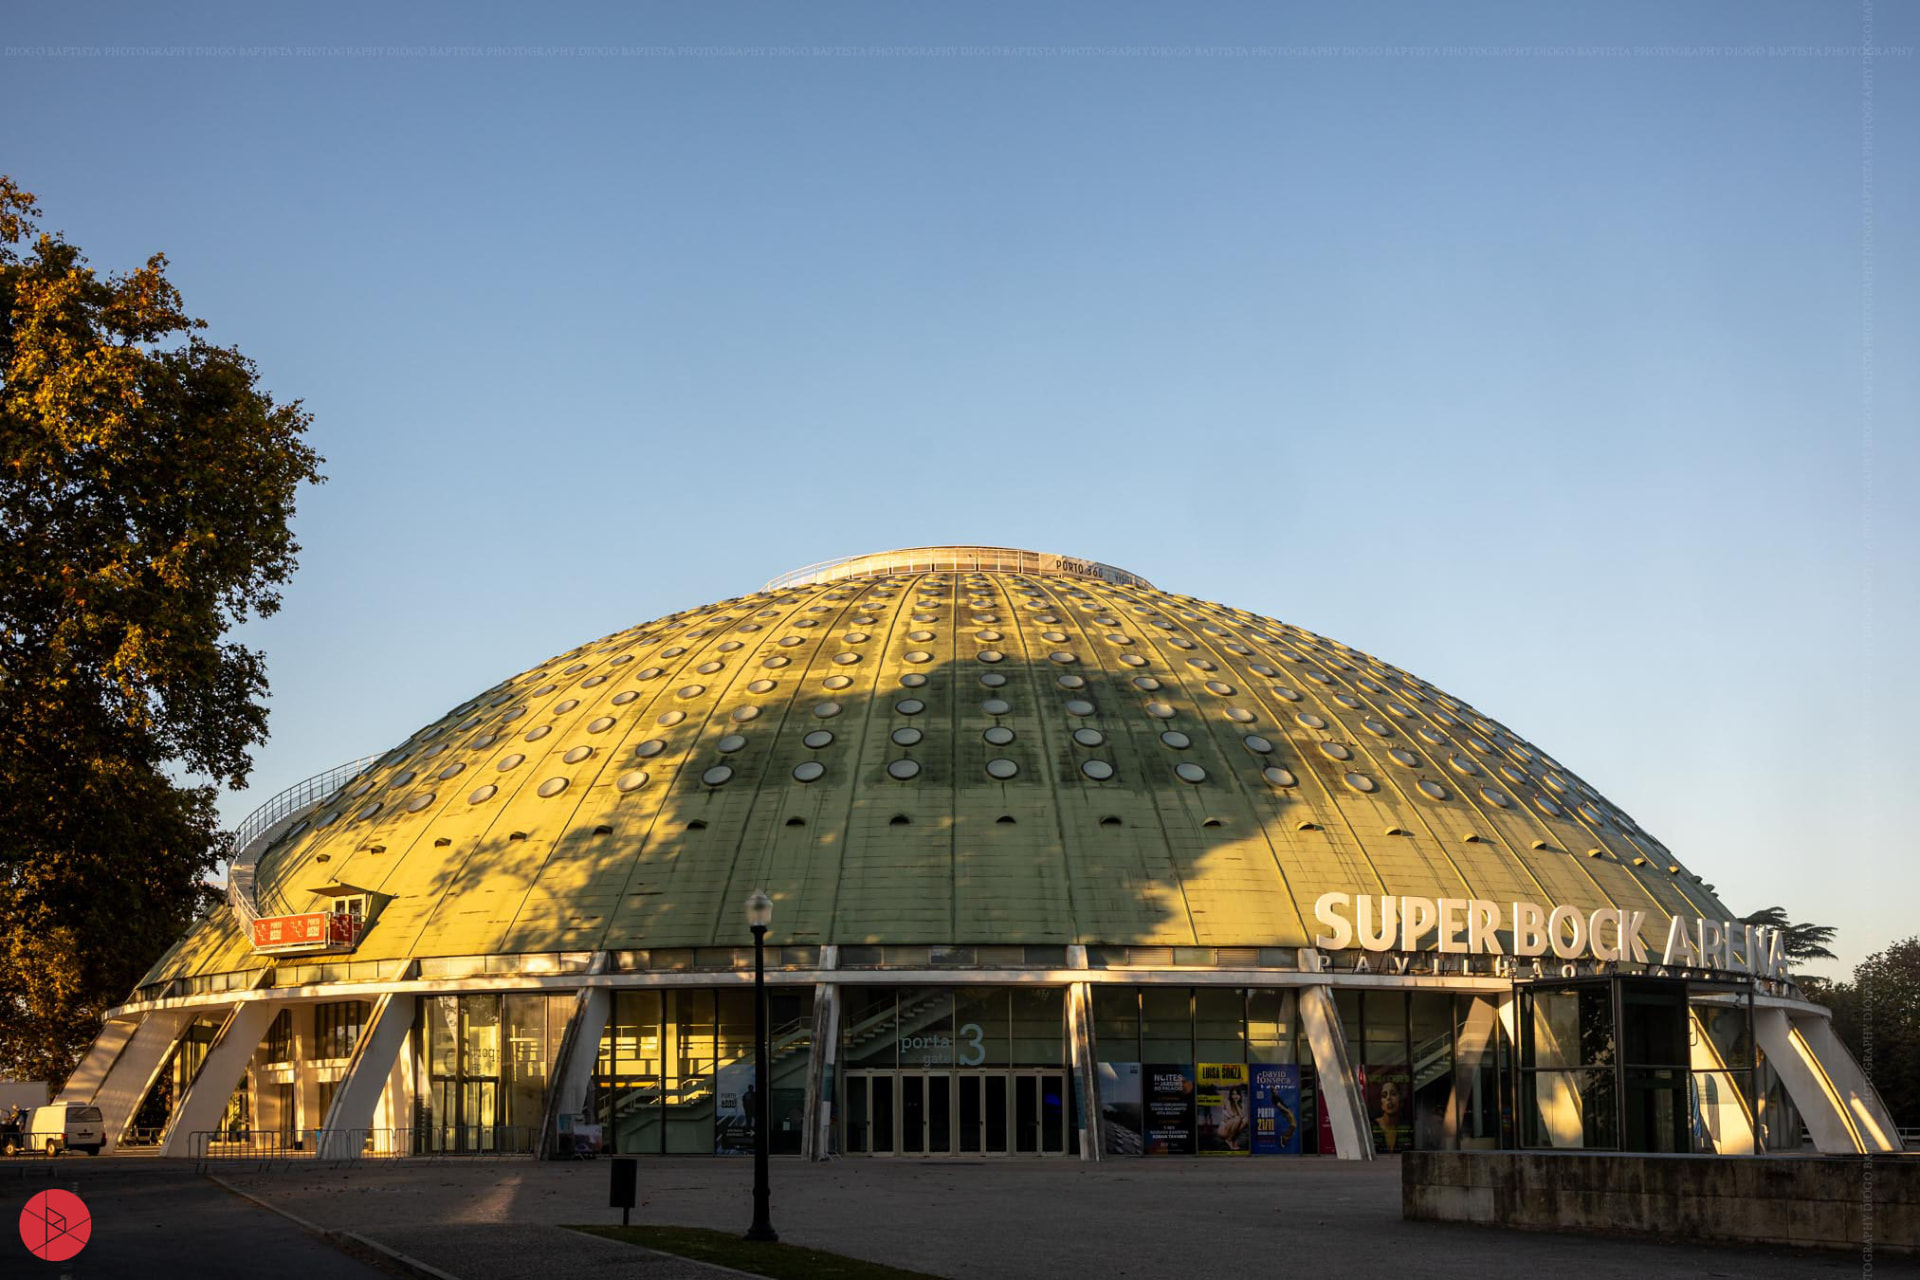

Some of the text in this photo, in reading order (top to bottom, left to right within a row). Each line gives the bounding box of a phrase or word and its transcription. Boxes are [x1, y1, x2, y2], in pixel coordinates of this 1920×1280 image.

[1056, 559, 1084, 575] PORTO
[1087, 566, 1103, 578] 360
[1315, 892, 1789, 979] SUPER BOCK ARENA
[899, 1023, 986, 1066] porta 3
[922, 1054, 952, 1068] gate
